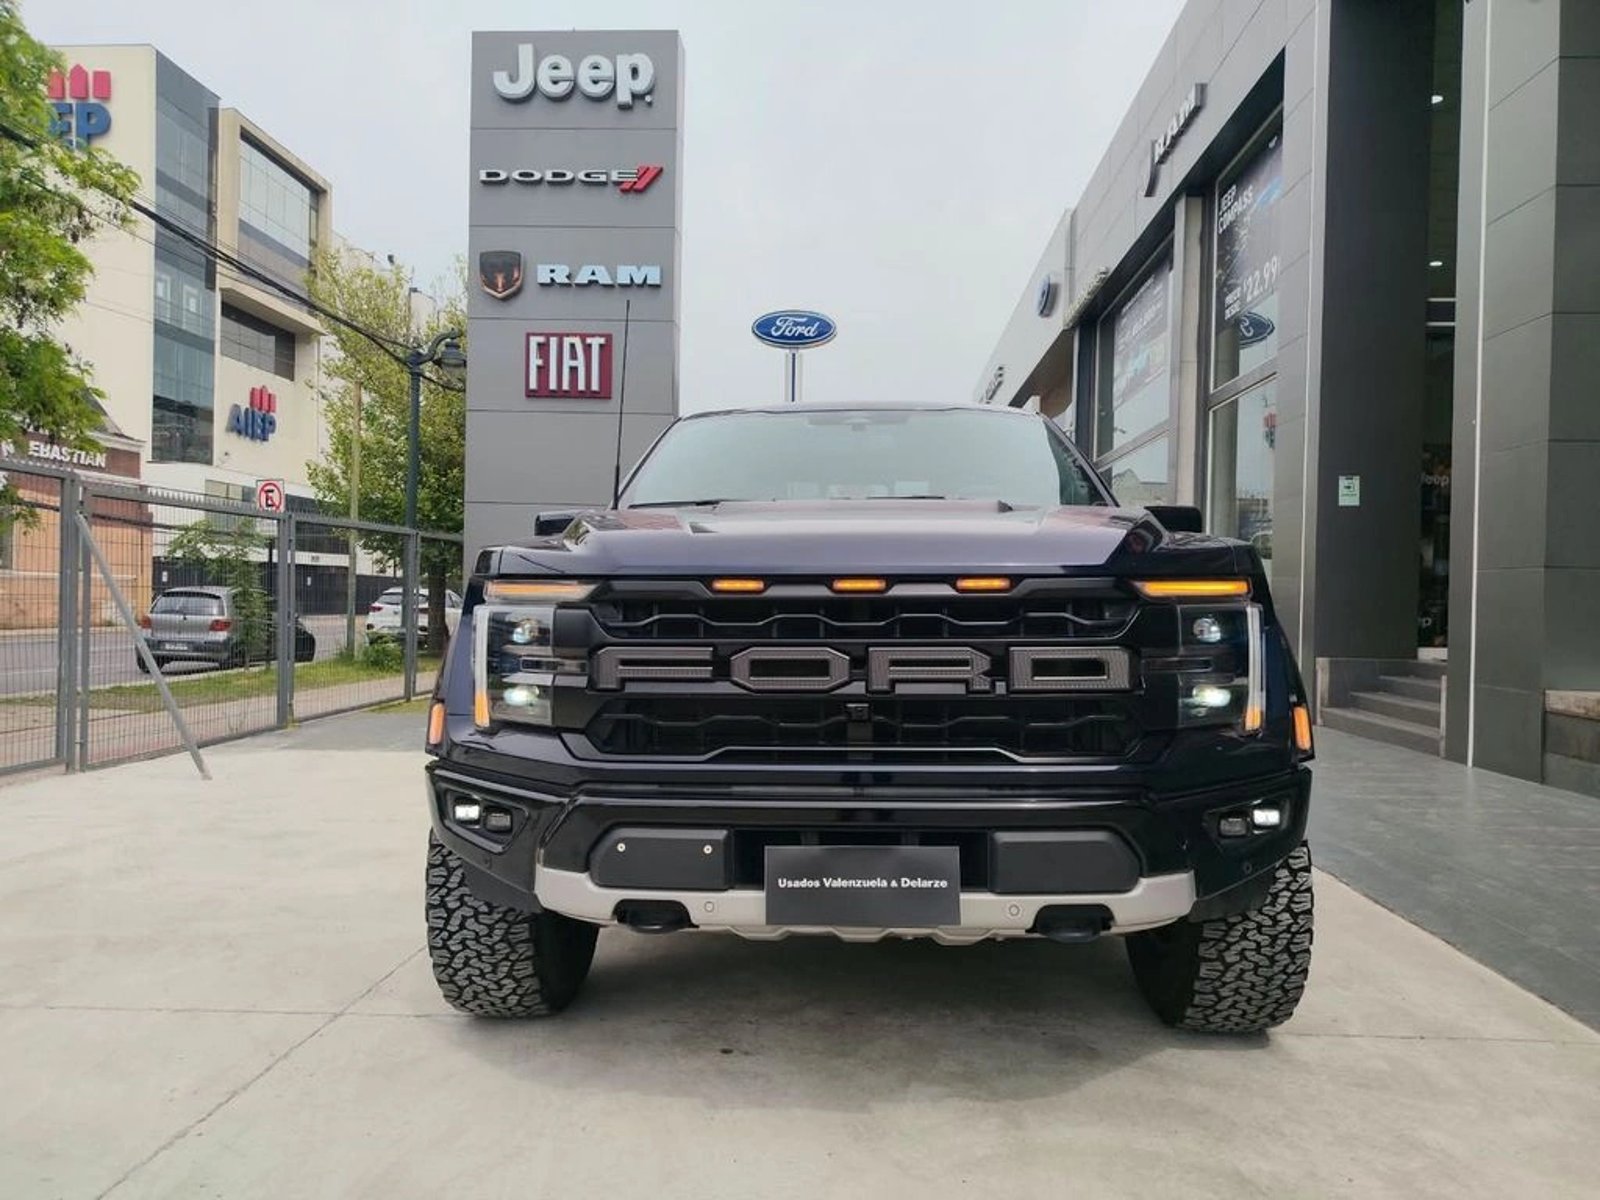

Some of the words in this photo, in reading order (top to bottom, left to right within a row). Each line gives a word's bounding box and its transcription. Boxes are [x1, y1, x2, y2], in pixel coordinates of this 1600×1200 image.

[493, 44, 655, 108] Jeep
[479, 169, 640, 185] DODGE
[536, 264, 661, 287] RAM
[771, 316, 820, 337] Ford
[528, 335, 606, 392] FIAT
[28, 440, 107, 468] EBASTIAN
[588, 646, 1133, 693] FORD
[778, 878, 820, 888] Usados
[822, 877, 887, 888] Valenzuela
